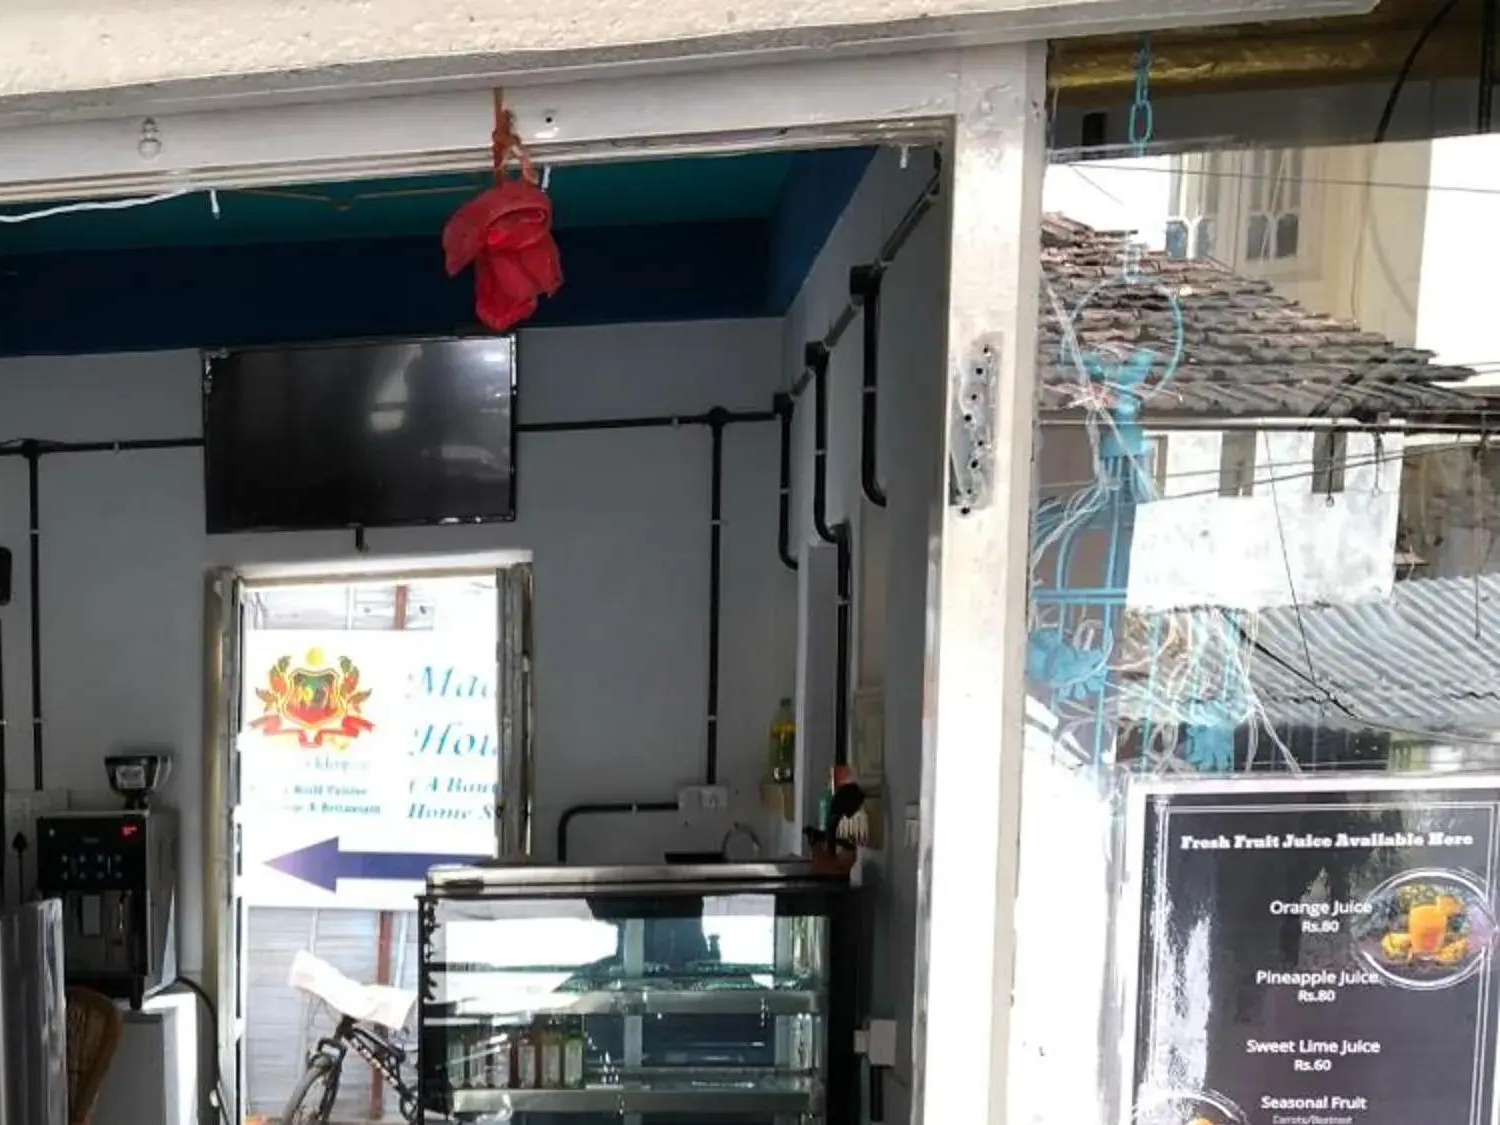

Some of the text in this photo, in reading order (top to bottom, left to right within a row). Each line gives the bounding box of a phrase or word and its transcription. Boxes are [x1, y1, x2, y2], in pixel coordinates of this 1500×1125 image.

[405, 665, 497, 698] Ma
[1180, 831, 1474, 850] Fresh Fruit Juice Available Here
[1269, 900, 1373, 918] Orange Juice
[1256, 970, 1380, 988] Pineapple Juice
[1297, 989, 1336, 1003] Rs.80
[1246, 1039, 1381, 1057] Sweet Lime Juice
[1293, 1059, 1332, 1072] Rs.60
[1260, 1095, 1368, 1110] Seasonal Fruit
